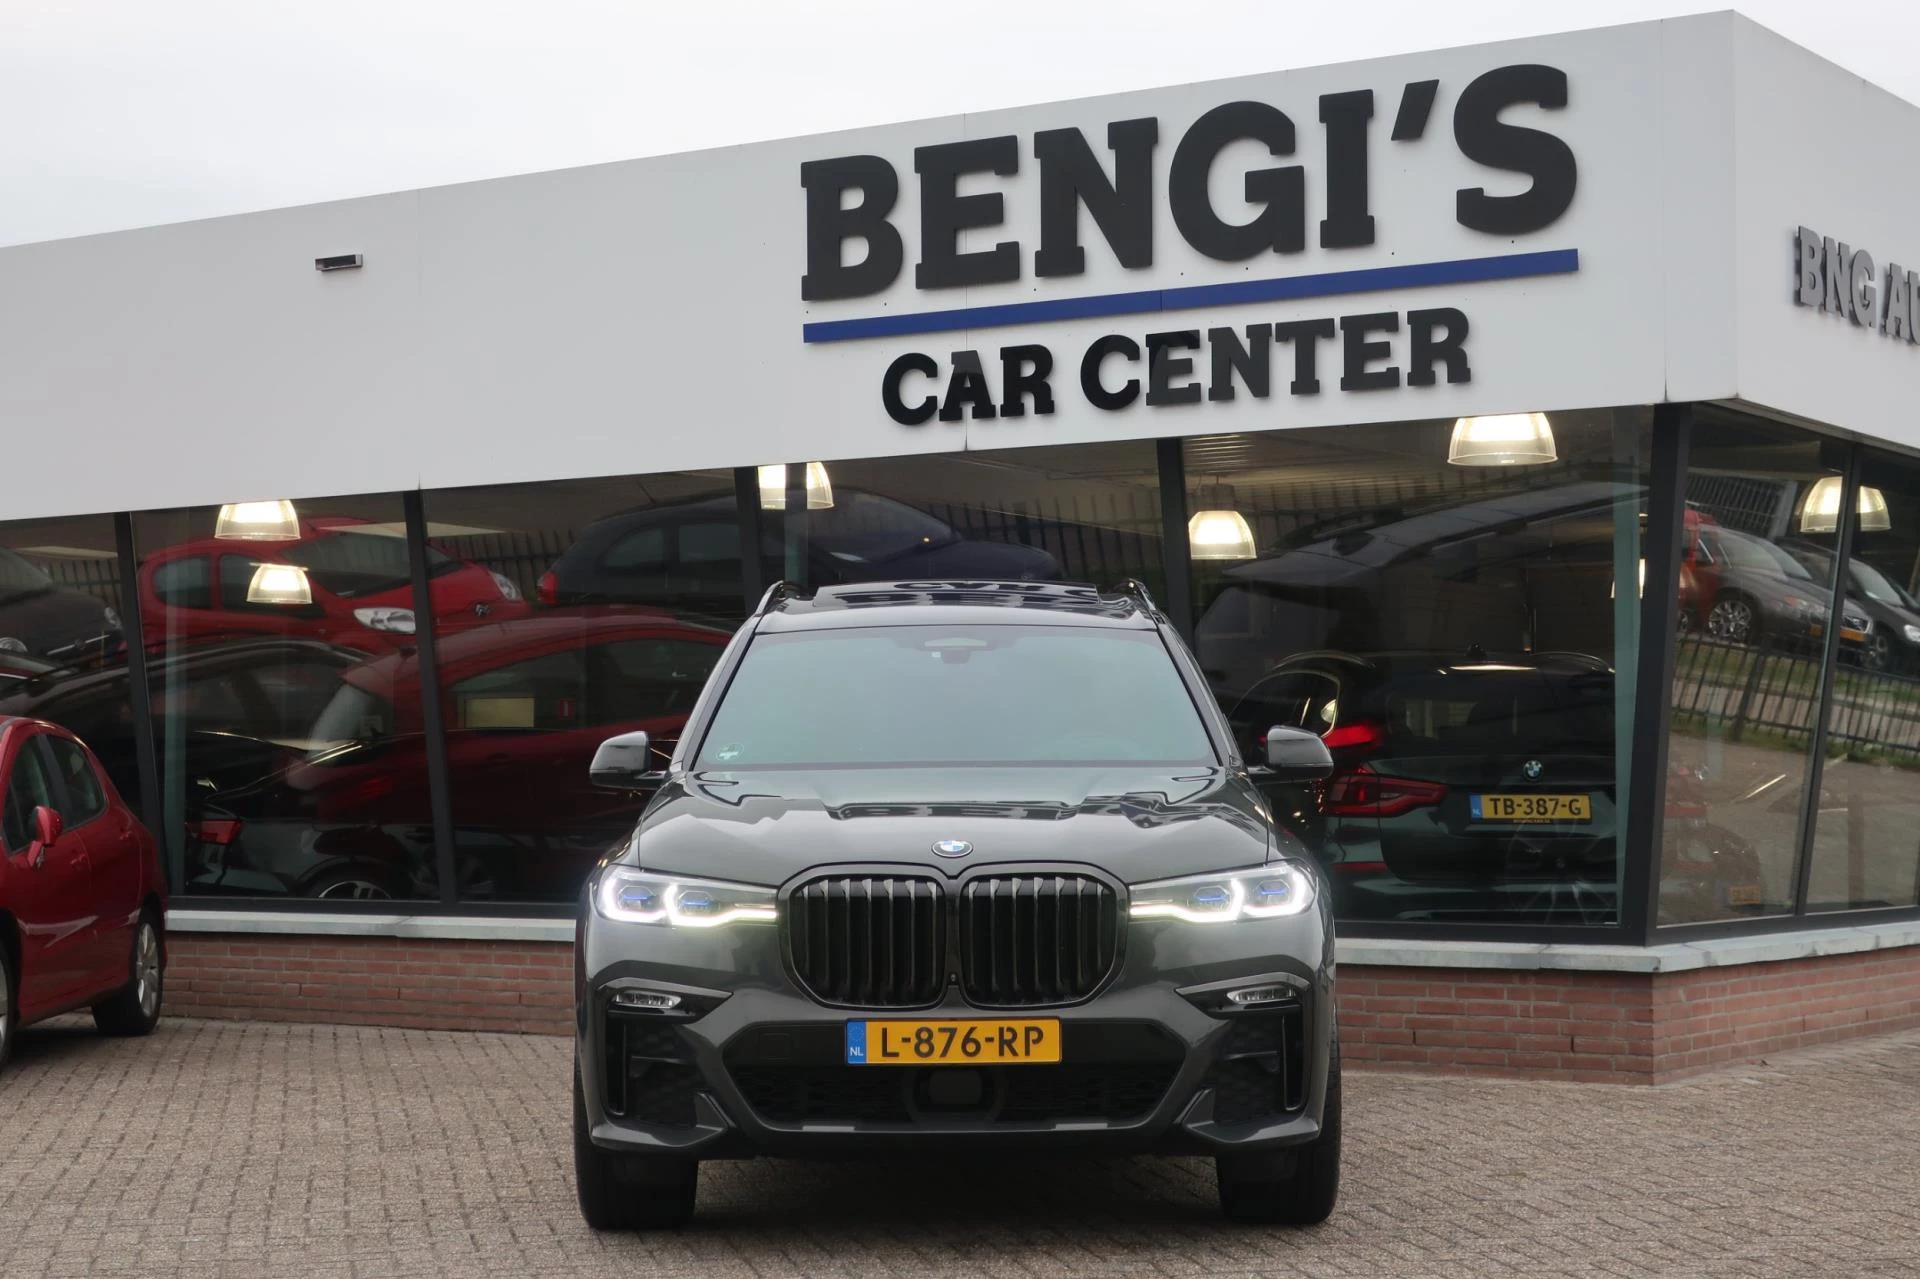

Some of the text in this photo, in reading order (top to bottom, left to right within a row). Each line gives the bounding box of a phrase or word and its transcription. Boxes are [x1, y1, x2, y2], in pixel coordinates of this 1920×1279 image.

[801, 64, 1578, 301] BENGI'S
[1794, 225, 1876, 329] BNG
[882, 307, 1471, 426] CAR CENTER
[1489, 798, 1581, 815] TB-387-G
[850, 1047, 864, 1057] NL
[881, 1026, 1044, 1058] L-876-RP
